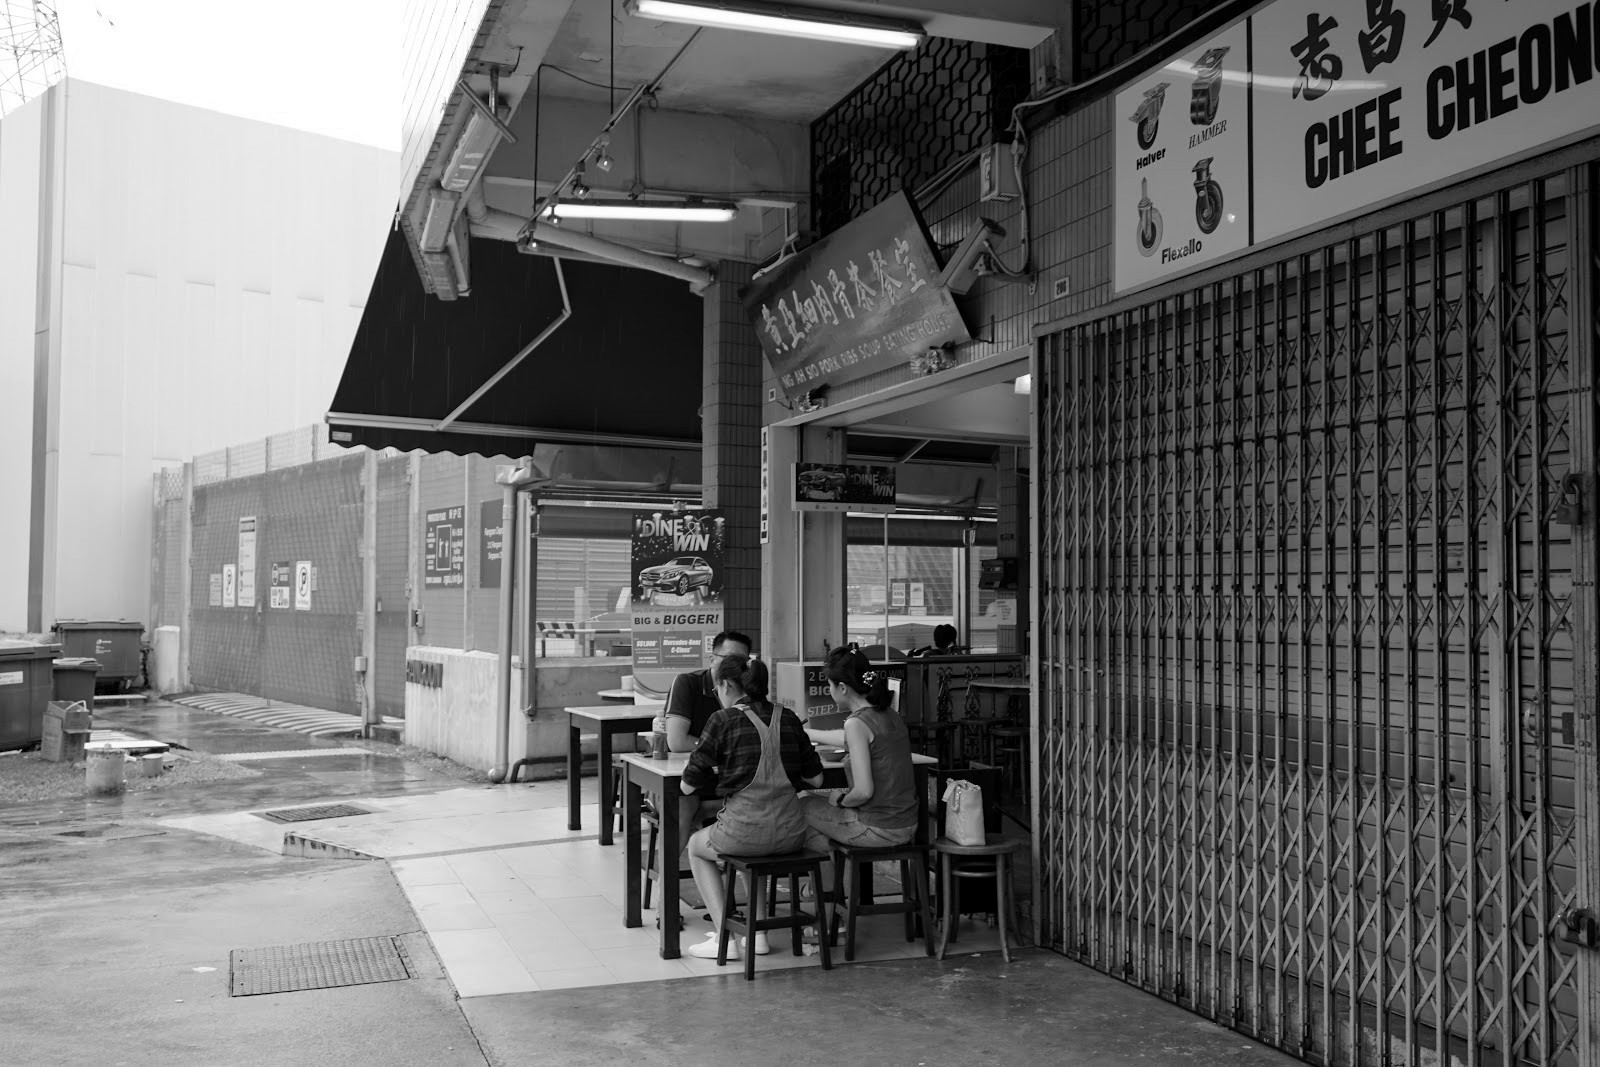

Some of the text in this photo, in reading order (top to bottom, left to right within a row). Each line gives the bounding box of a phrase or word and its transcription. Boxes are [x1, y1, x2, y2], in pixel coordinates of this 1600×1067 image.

[1304, 2, 1600, 189] CHEE CHEON
[1188, 120, 1228, 150] HAMMER
[1136, 147, 1167, 170] Halver
[1161, 238, 1203, 265] Flexello
[780, 312, 953, 389] NG AH SIO PORK RIBS SOUP EATING HOUSE
[854, 473, 878, 485] DINE
[872, 485, 894, 497] WIN
[642, 518, 684, 538] DINE
[674, 534, 710, 552] WIN
[663, 614, 719, 624] BIGGER!
[809, 672, 815, 682] 2
[809, 686, 831, 696] BIG
[808, 703, 840, 717] STEP 1
